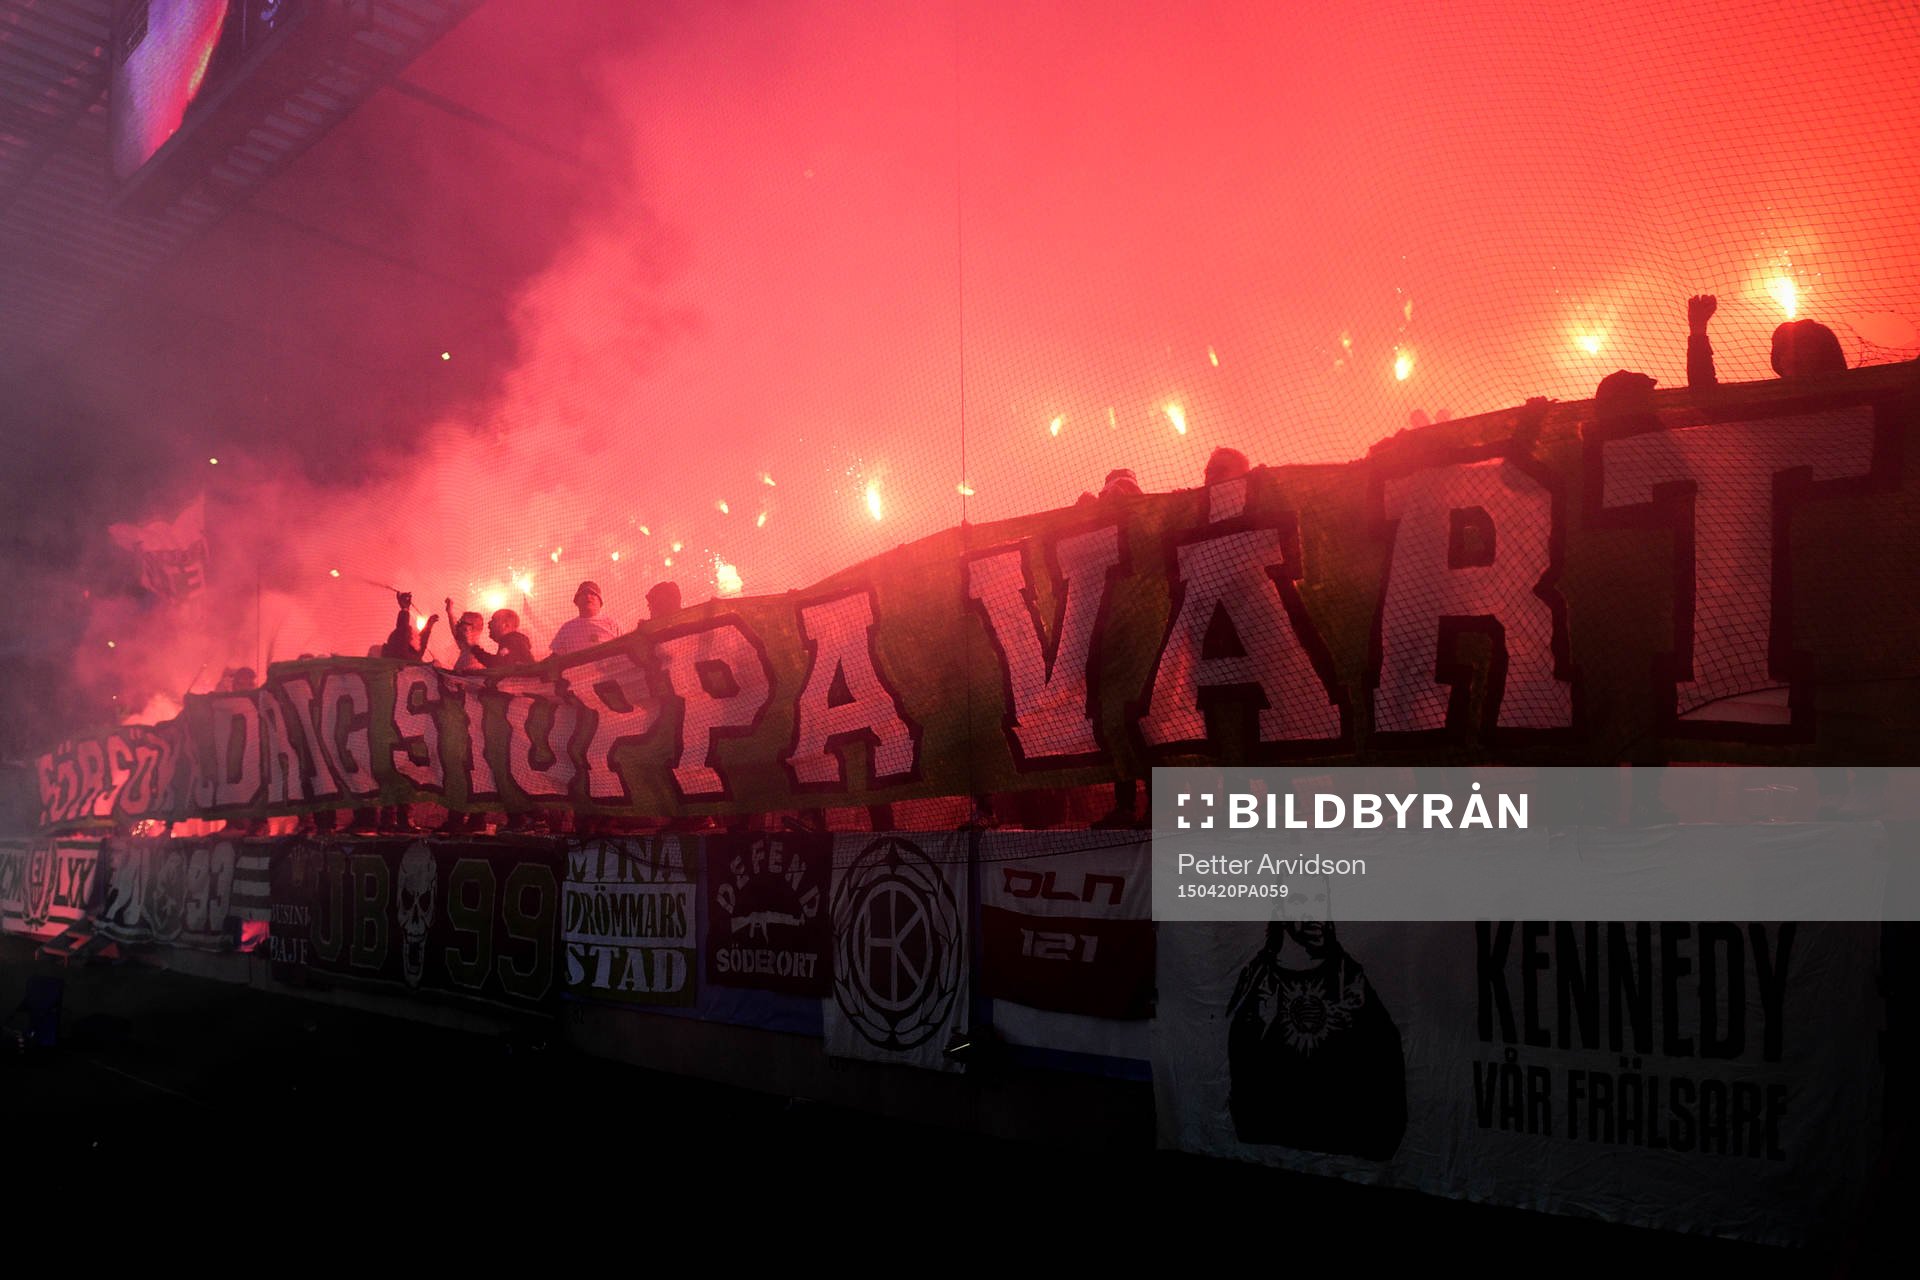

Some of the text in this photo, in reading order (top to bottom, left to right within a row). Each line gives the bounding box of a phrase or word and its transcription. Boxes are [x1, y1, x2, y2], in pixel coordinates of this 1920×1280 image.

[182, 672, 380, 808] DRIG
[967, 403, 1876, 760] VÅRT
[566, 838, 689, 883] MINA
[716, 839, 821, 918] DEFEND
[444, 857, 559, 1003] 99
[565, 885, 688, 939] DRÖMMARS
[565, 943, 688, 993] STAD
[715, 944, 819, 980] SÖDERORT
[1019, 927, 1099, 964] 121
[1474, 917, 1797, 1063] KENNEDY
[1472, 1047, 1788, 1162] VÅR FRÄLSARE
